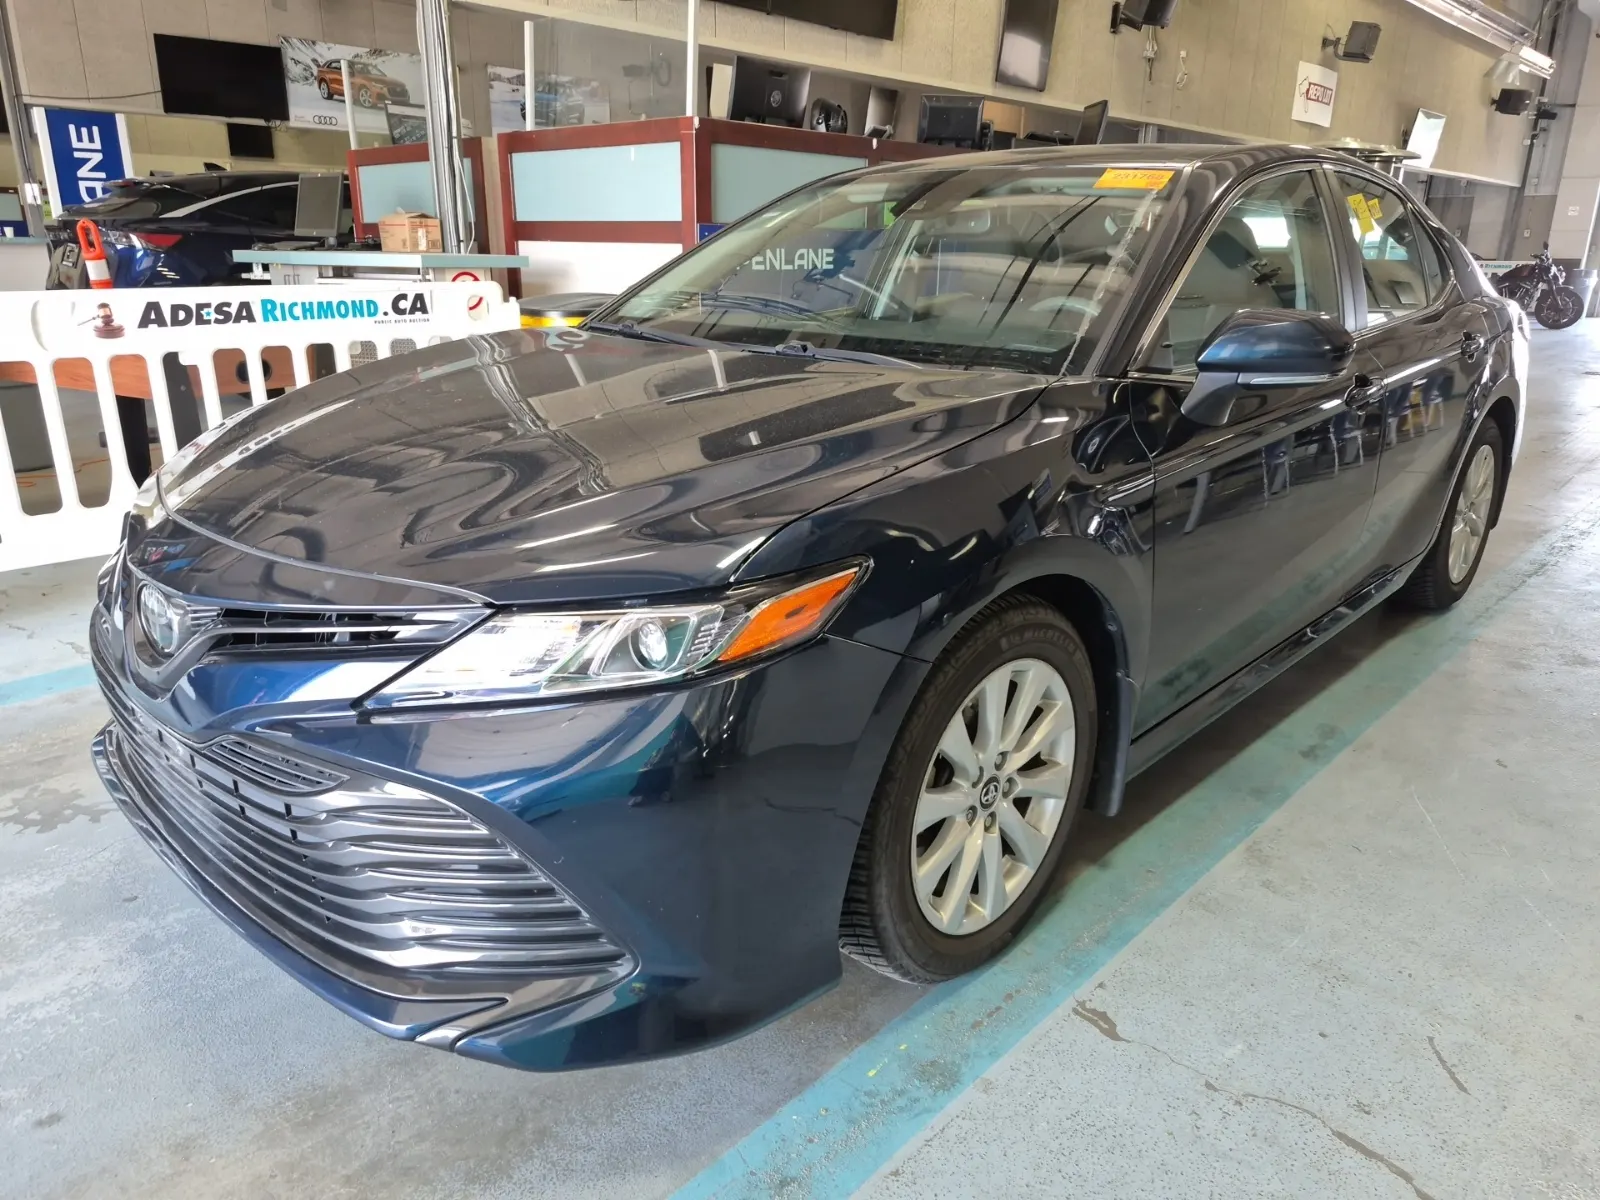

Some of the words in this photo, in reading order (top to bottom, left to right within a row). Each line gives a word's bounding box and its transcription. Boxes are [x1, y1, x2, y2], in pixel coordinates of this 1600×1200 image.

[1308, 84, 1324, 101] REPO
[736, 248, 834, 270] ENLANE
[137, 301, 256, 328] ADESA
